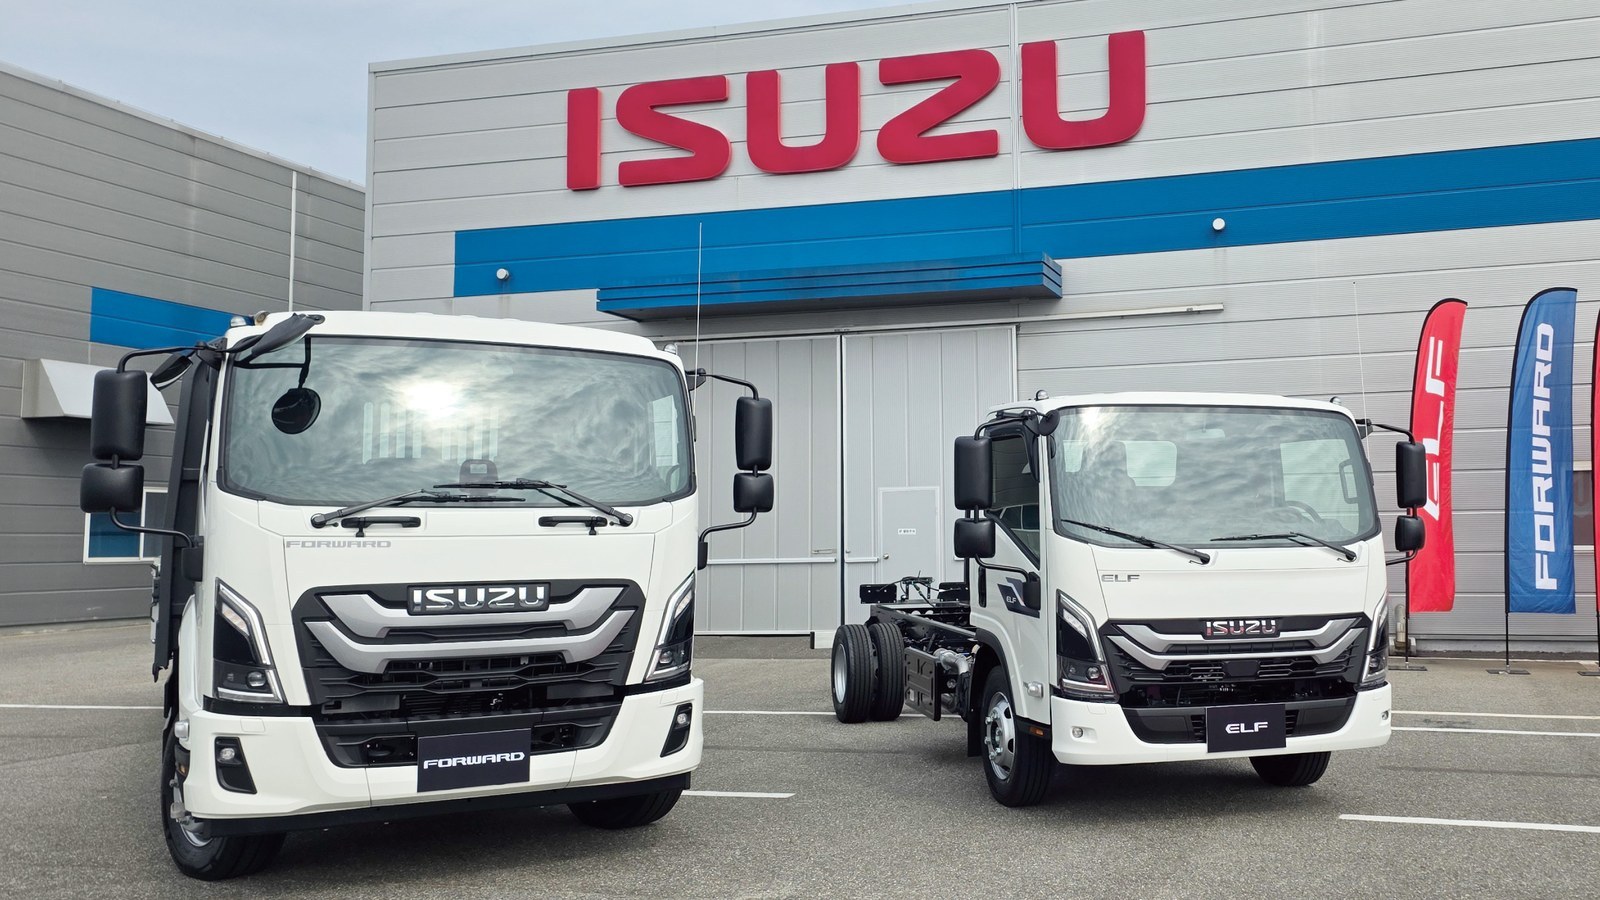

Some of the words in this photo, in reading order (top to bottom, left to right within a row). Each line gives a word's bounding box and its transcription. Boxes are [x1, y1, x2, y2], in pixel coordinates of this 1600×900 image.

[567, 30, 1146, 191] ISUZU
[1422, 336, 1444, 521] ELF
[1532, 322, 1557, 590] FORWARD
[286, 540, 391, 549] FORWARD
[1101, 574, 1140, 582] ELF
[413, 586, 545, 612] ISUZU
[1206, 619, 1276, 636] ISUZU
[1225, 721, 1269, 734] ELF
[423, 752, 525, 769] FORWARD
